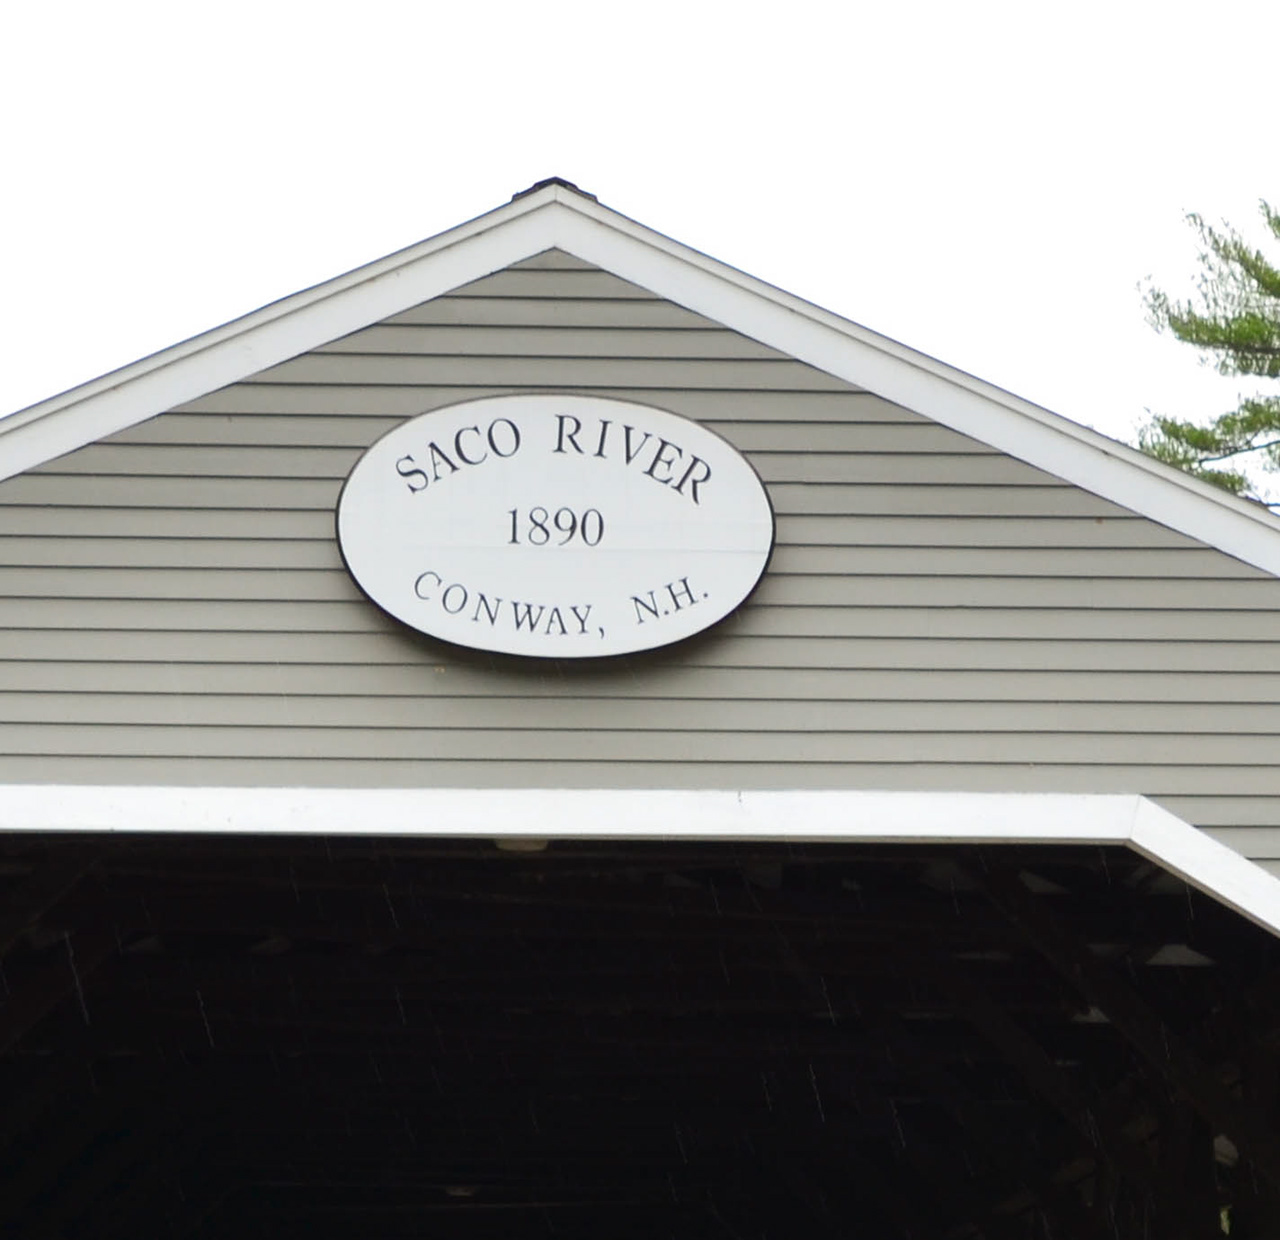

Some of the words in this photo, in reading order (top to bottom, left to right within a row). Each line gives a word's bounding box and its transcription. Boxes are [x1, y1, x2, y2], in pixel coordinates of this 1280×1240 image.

[395, 418, 521, 494] SACO
[553, 414, 713, 505] RIVER
[507, 506, 605, 547] 1890
[413, 571, 606, 639] CONWAY,
[630, 576, 710, 625] N.H.
